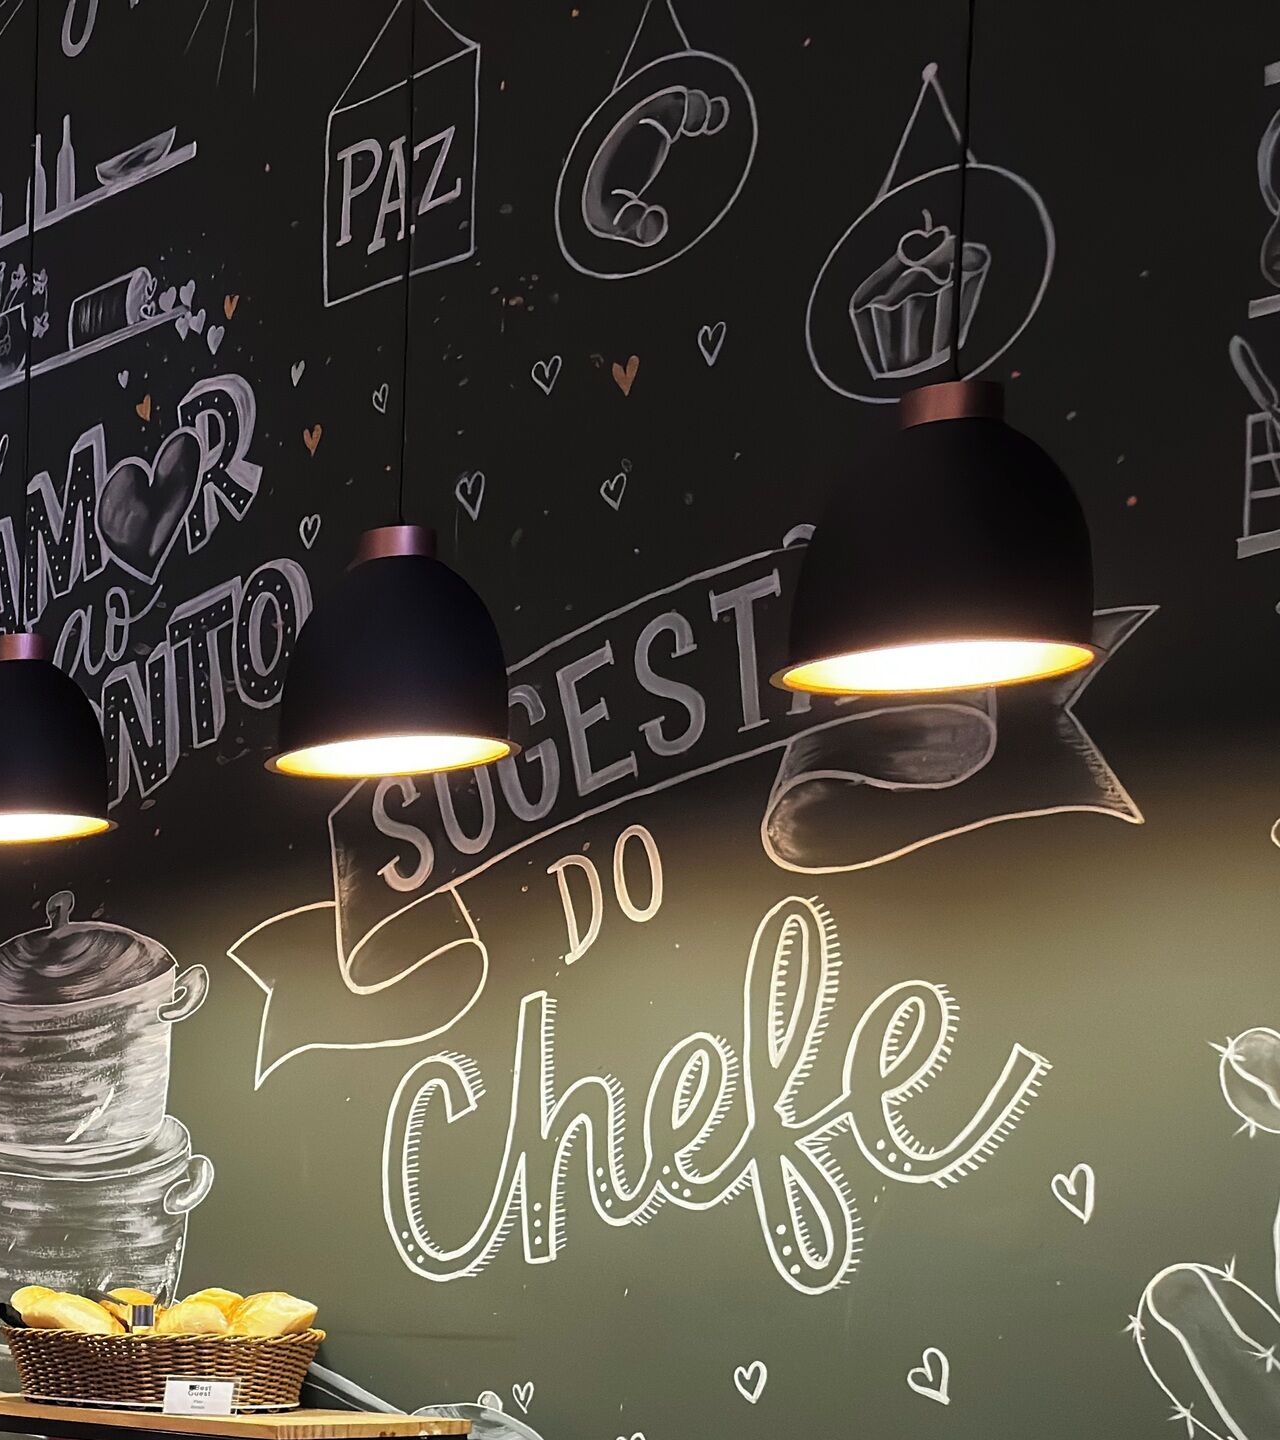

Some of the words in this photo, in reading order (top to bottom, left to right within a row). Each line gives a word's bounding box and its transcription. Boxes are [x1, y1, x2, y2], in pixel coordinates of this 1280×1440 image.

[336, 126, 462, 256] PAZ
[547, 824, 663, 964] DO
[383, 894, 1051, 1295] Chefe
